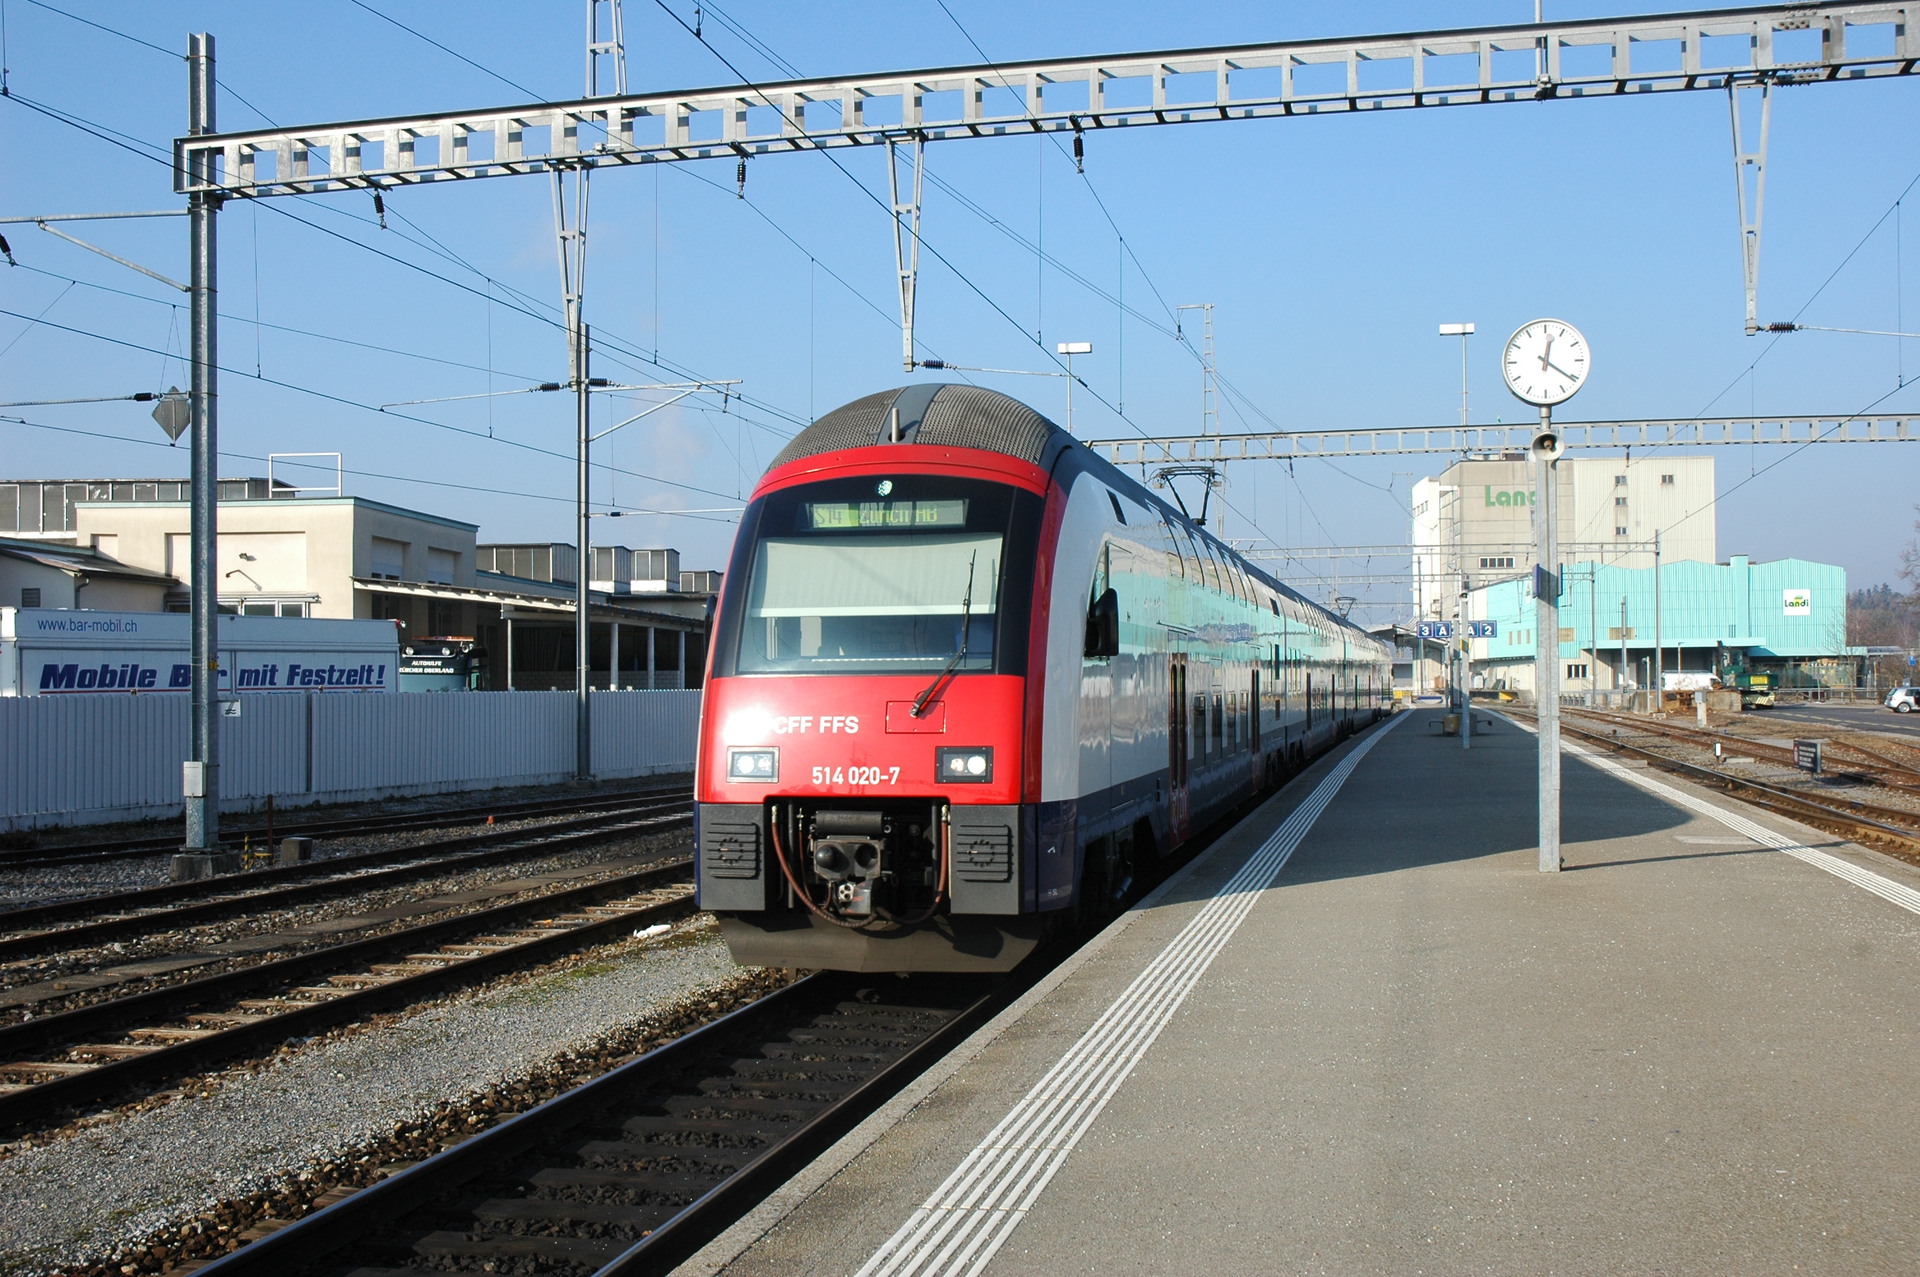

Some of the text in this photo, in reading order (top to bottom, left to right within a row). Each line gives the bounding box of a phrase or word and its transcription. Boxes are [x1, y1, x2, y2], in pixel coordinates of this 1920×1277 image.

[815, 506, 843, 525] S14
[915, 503, 939, 523] HB
[1784, 599, 1809, 607] Landi
[37, 618, 138, 632] www.bar-mobil.ch
[1421, 626, 1447, 636] 3 A
[1484, 625, 1493, 635] 2
[39, 664, 157, 689] Mobile
[238, 664, 279, 686] mit
[286, 664, 386, 686] Festzelt!
[773, 716, 859, 734] CFF FFS
[812, 766, 901, 785] 514 020-7
